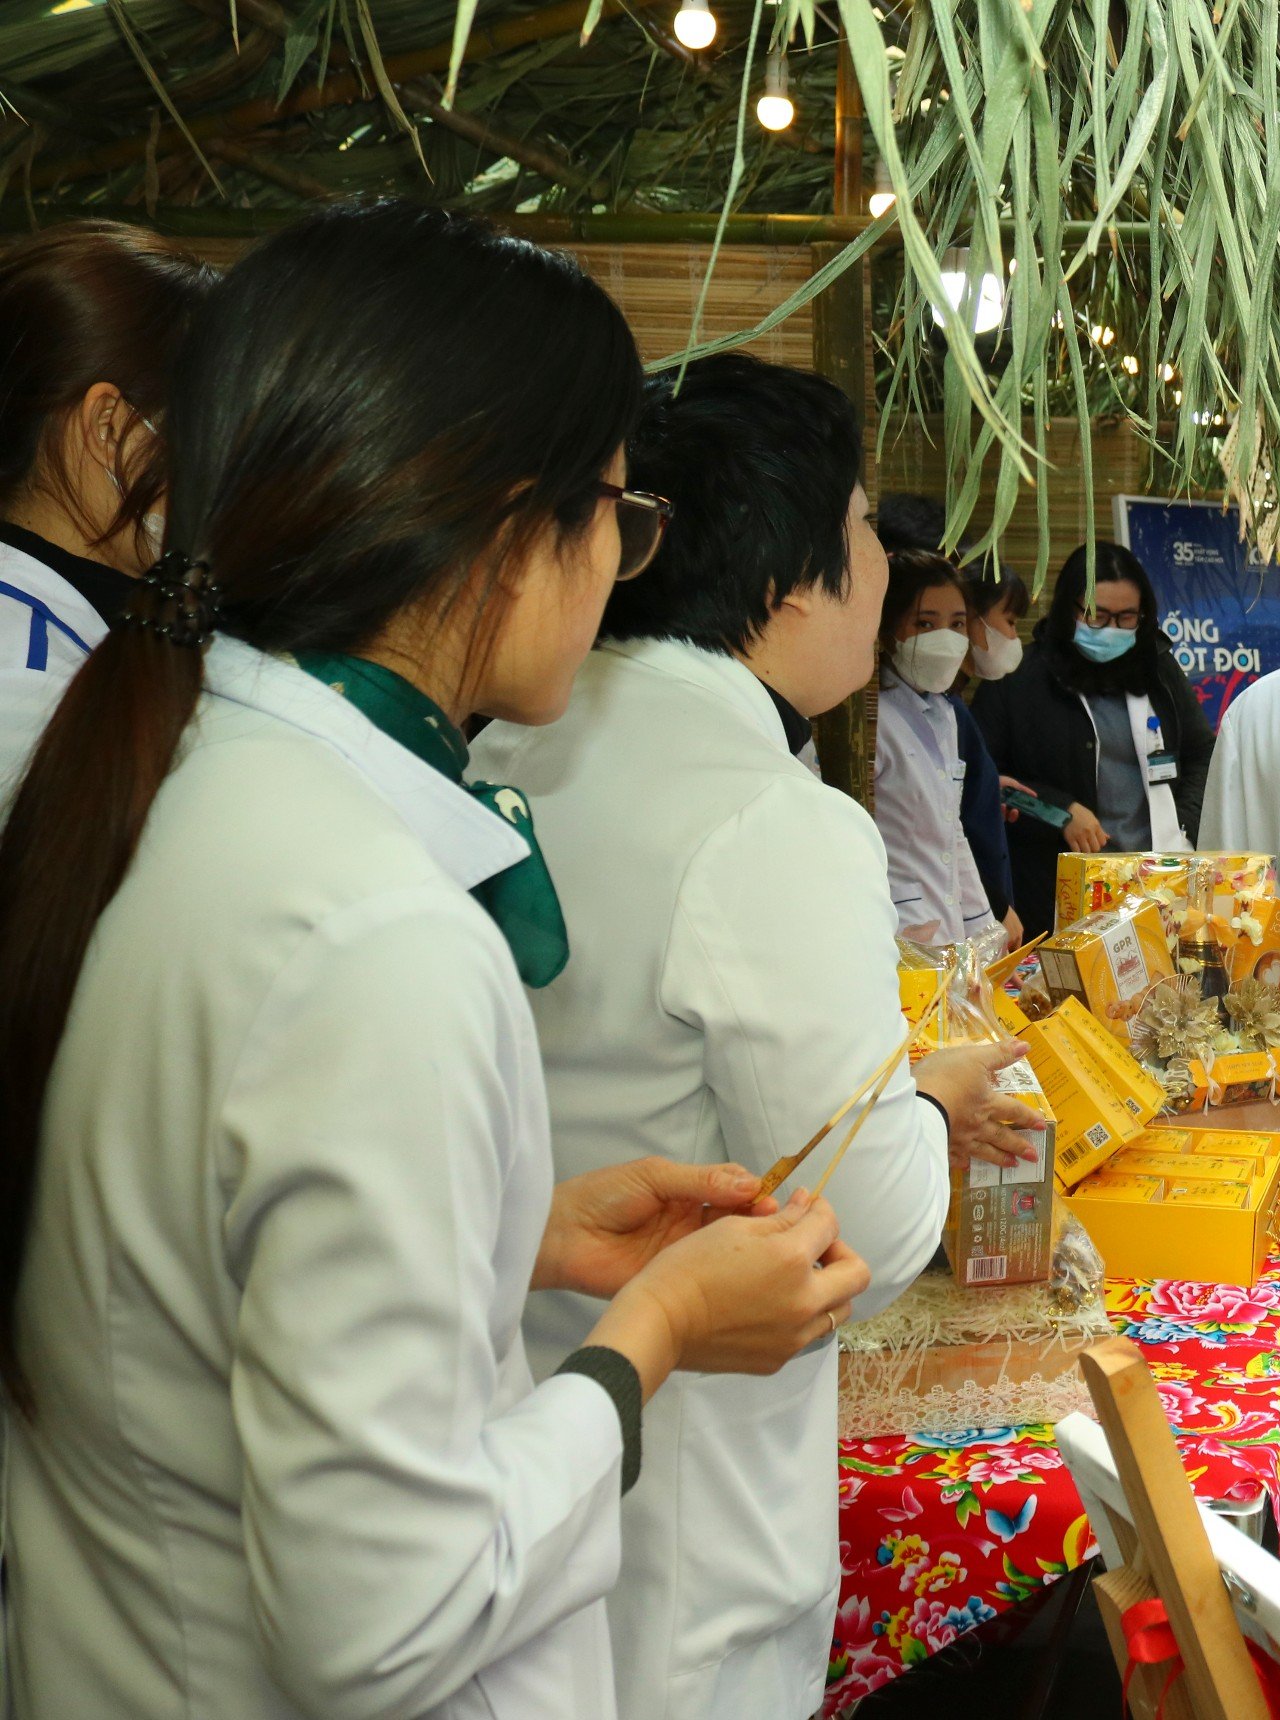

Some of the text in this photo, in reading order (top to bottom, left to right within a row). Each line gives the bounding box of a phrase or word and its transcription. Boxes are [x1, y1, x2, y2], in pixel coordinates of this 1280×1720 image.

[1172, 541, 1194, 562] 35
[1157, 609, 1220, 644] ỐNG
[1169, 641, 1260, 677] ỘT ĐỜI
[1112, 936, 1133, 954] GPR
